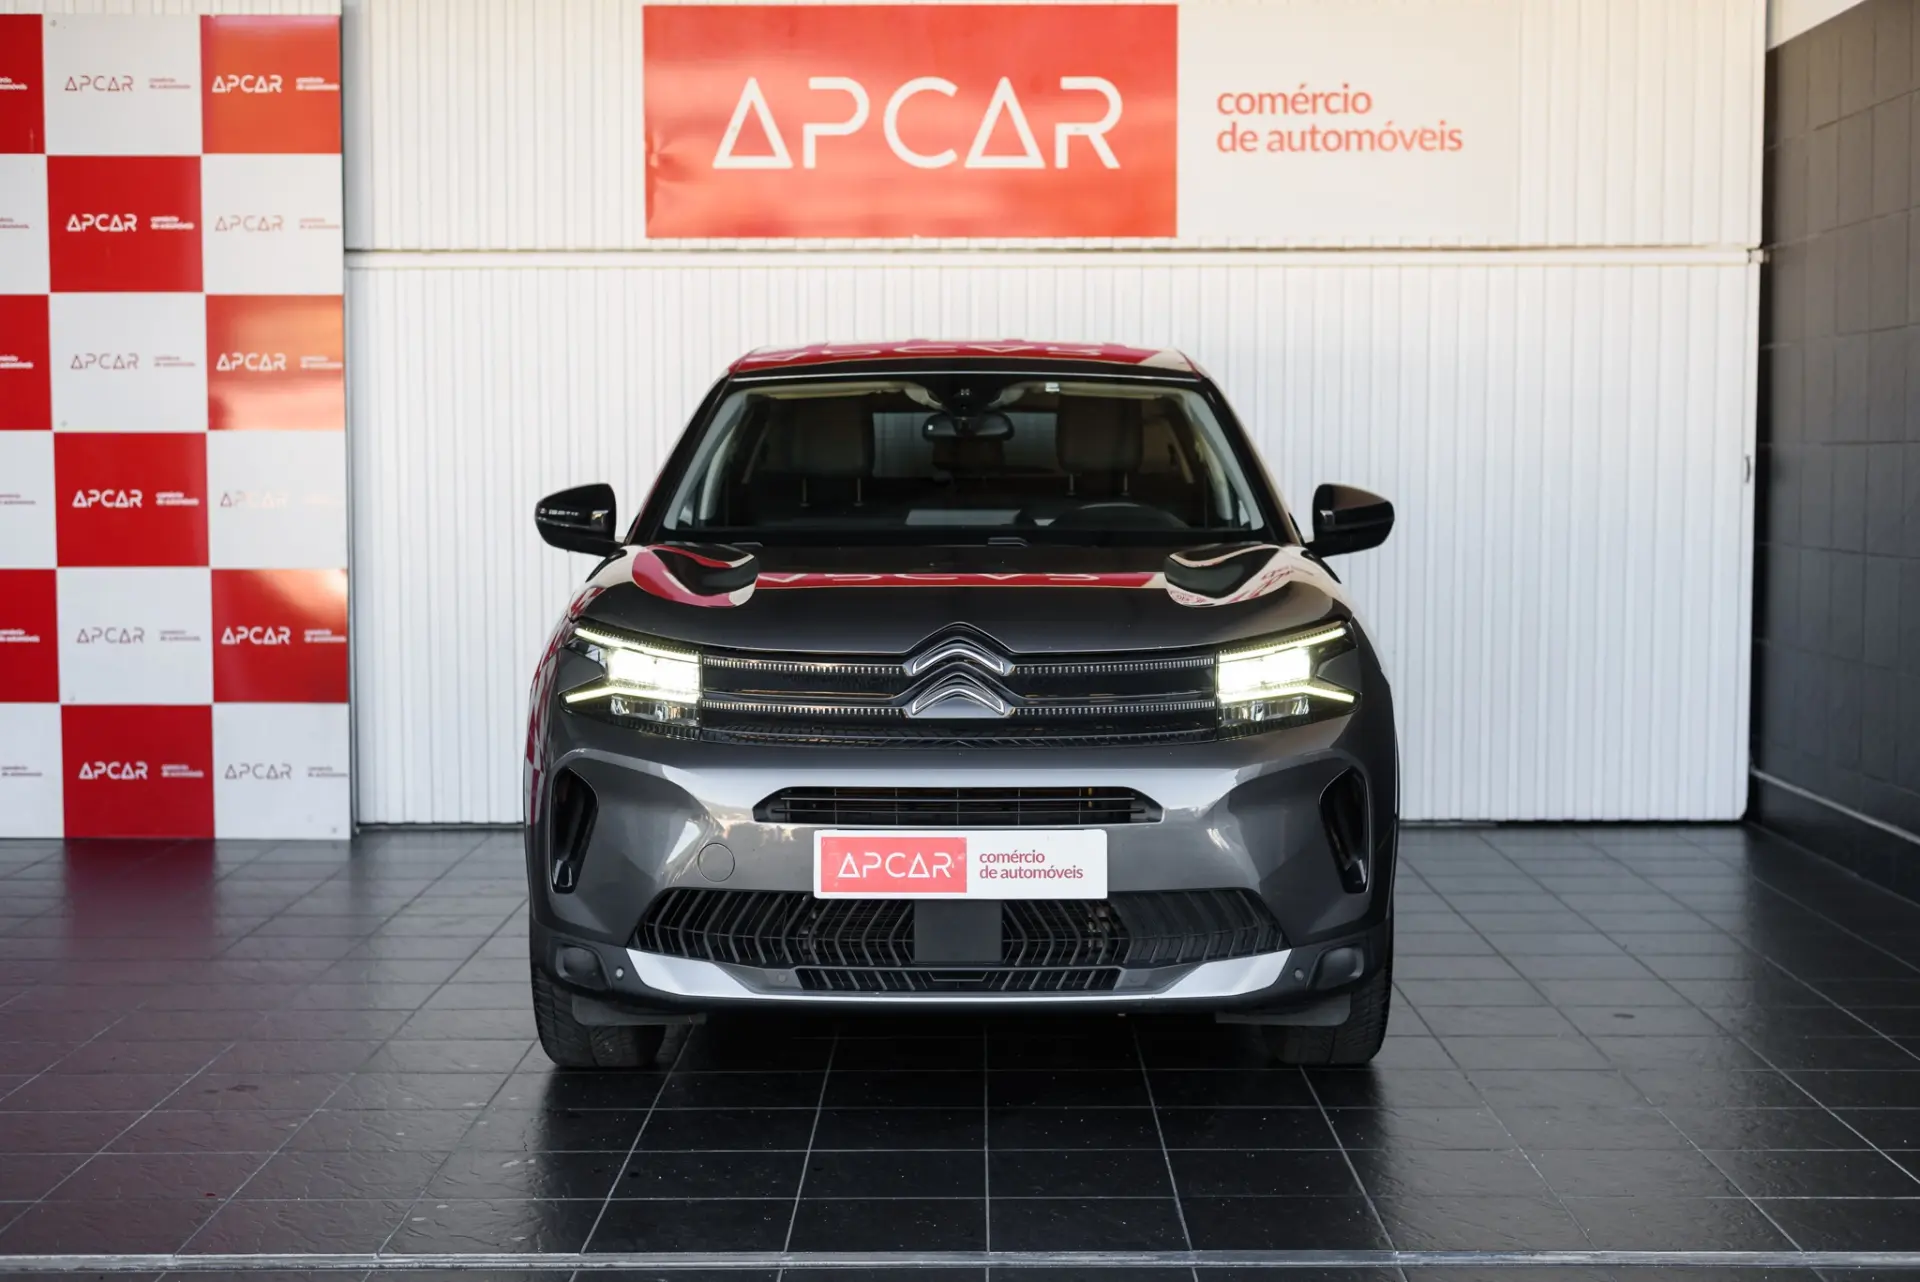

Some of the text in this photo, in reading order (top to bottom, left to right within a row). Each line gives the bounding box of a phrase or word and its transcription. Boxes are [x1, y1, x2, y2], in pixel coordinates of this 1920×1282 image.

[64, 75, 134, 92] APCAR
[211, 74, 283, 93] APCAR
[1216, 83, 1373, 116] comércio
[712, 76, 1123, 170] APCAR
[1216, 120, 1464, 153] de automóveis
[66, 213, 138, 232] APCAR
[214, 215, 284, 232] APCAR
[70, 352, 140, 370] APCAR
[216, 352, 287, 371] APCAR
[72, 489, 143, 508] APCAR
[76, 627, 146, 644] APCAR
[221, 626, 291, 645] APCAR
[78, 761, 149, 780] APCAR
[224, 763, 293, 780] APCAR
[837, 852, 952, 878] APCAR
[979, 849, 1046, 864] comércio
[979, 865, 1084, 879] de automóveis
